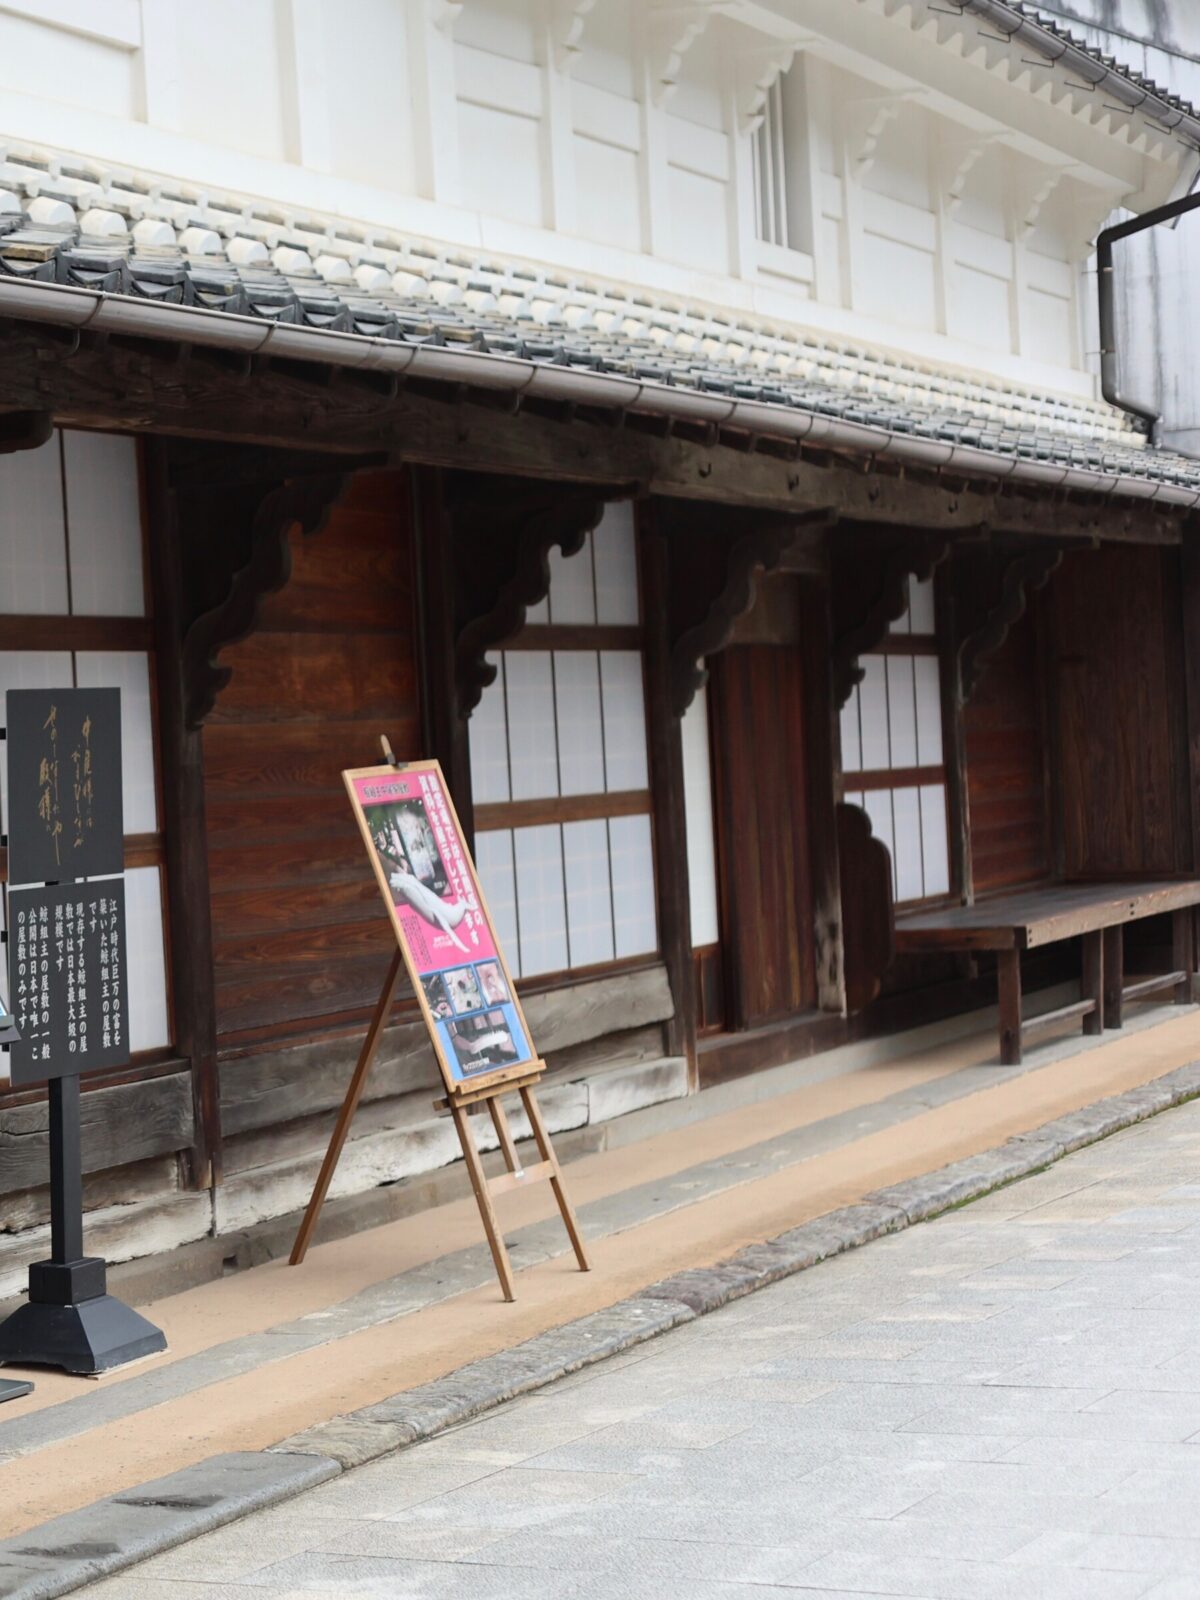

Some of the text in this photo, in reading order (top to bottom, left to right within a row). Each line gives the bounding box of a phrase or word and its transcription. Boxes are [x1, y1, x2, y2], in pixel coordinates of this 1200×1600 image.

[17, 911, 28, 1030] の屋敷のみです
[28, 907, 40, 1060] 公開は日本で唯一こ
[39, 905, 51, 1060] 鯨組主の屋敷の一般
[55, 904, 64, 973] 規模です
[65, 902, 77, 1053] 敷では日本最大級の
[76, 902, 88, 1053] 現存する鯨組主の屋
[89, 901, 97, 934] です
[100, 898, 112, 1049] 築いた鯨組主の屋敷
[109, 898, 121, 1046] 江戸時代巨万の富を
